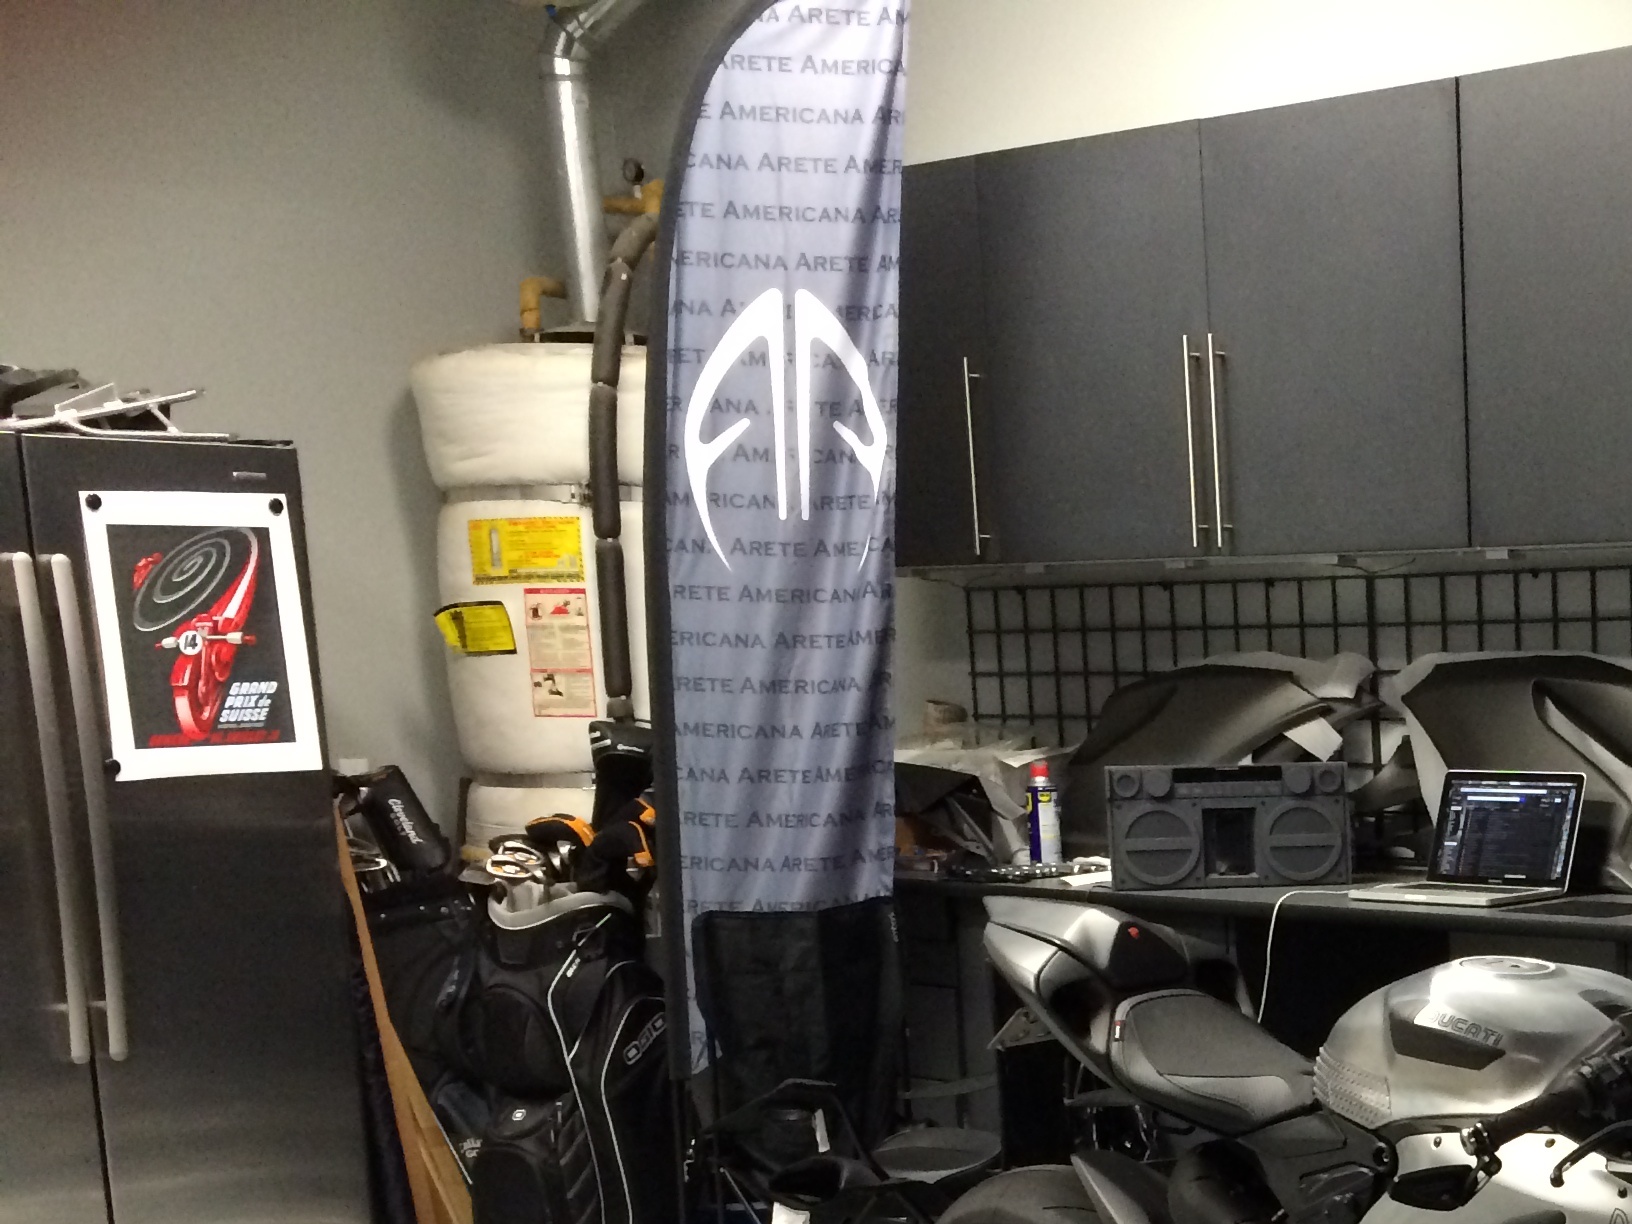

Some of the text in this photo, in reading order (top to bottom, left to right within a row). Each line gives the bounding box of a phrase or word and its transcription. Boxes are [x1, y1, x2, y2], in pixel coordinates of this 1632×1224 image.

[788, 5, 871, 27] ARETE
[719, 101, 864, 124] AMERICANA
[757, 152, 838, 173] ARETE
[723, 200, 867, 223] AMERICANA
[183, 633, 198, 650] 14
[773, 631, 846, 650] ARETE
[229, 681, 278, 695] GRAND
[224, 694, 271, 709] PRIX de
[219, 707, 270, 722] SUISSE
